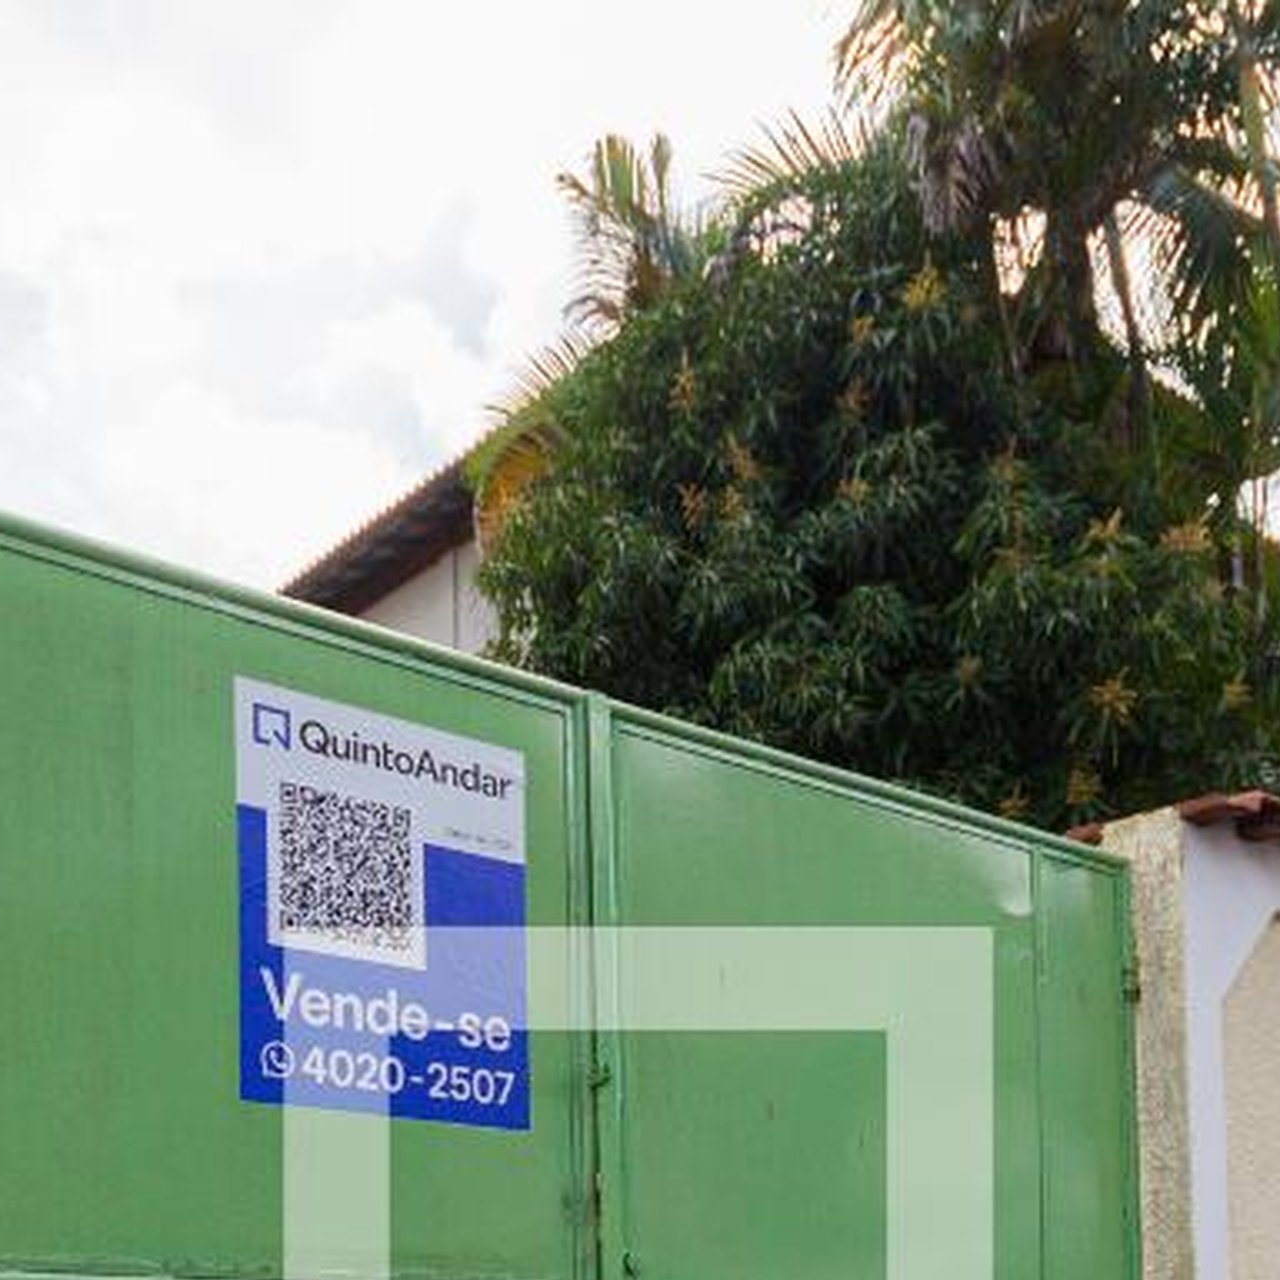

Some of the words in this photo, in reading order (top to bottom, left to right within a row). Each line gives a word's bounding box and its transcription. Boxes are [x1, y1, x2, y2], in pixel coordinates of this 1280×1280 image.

[299, 720, 513, 799] QuintoAndar
[260, 967, 511, 1051] Vende-se
[301, 1046, 515, 1105] 4020-2507
